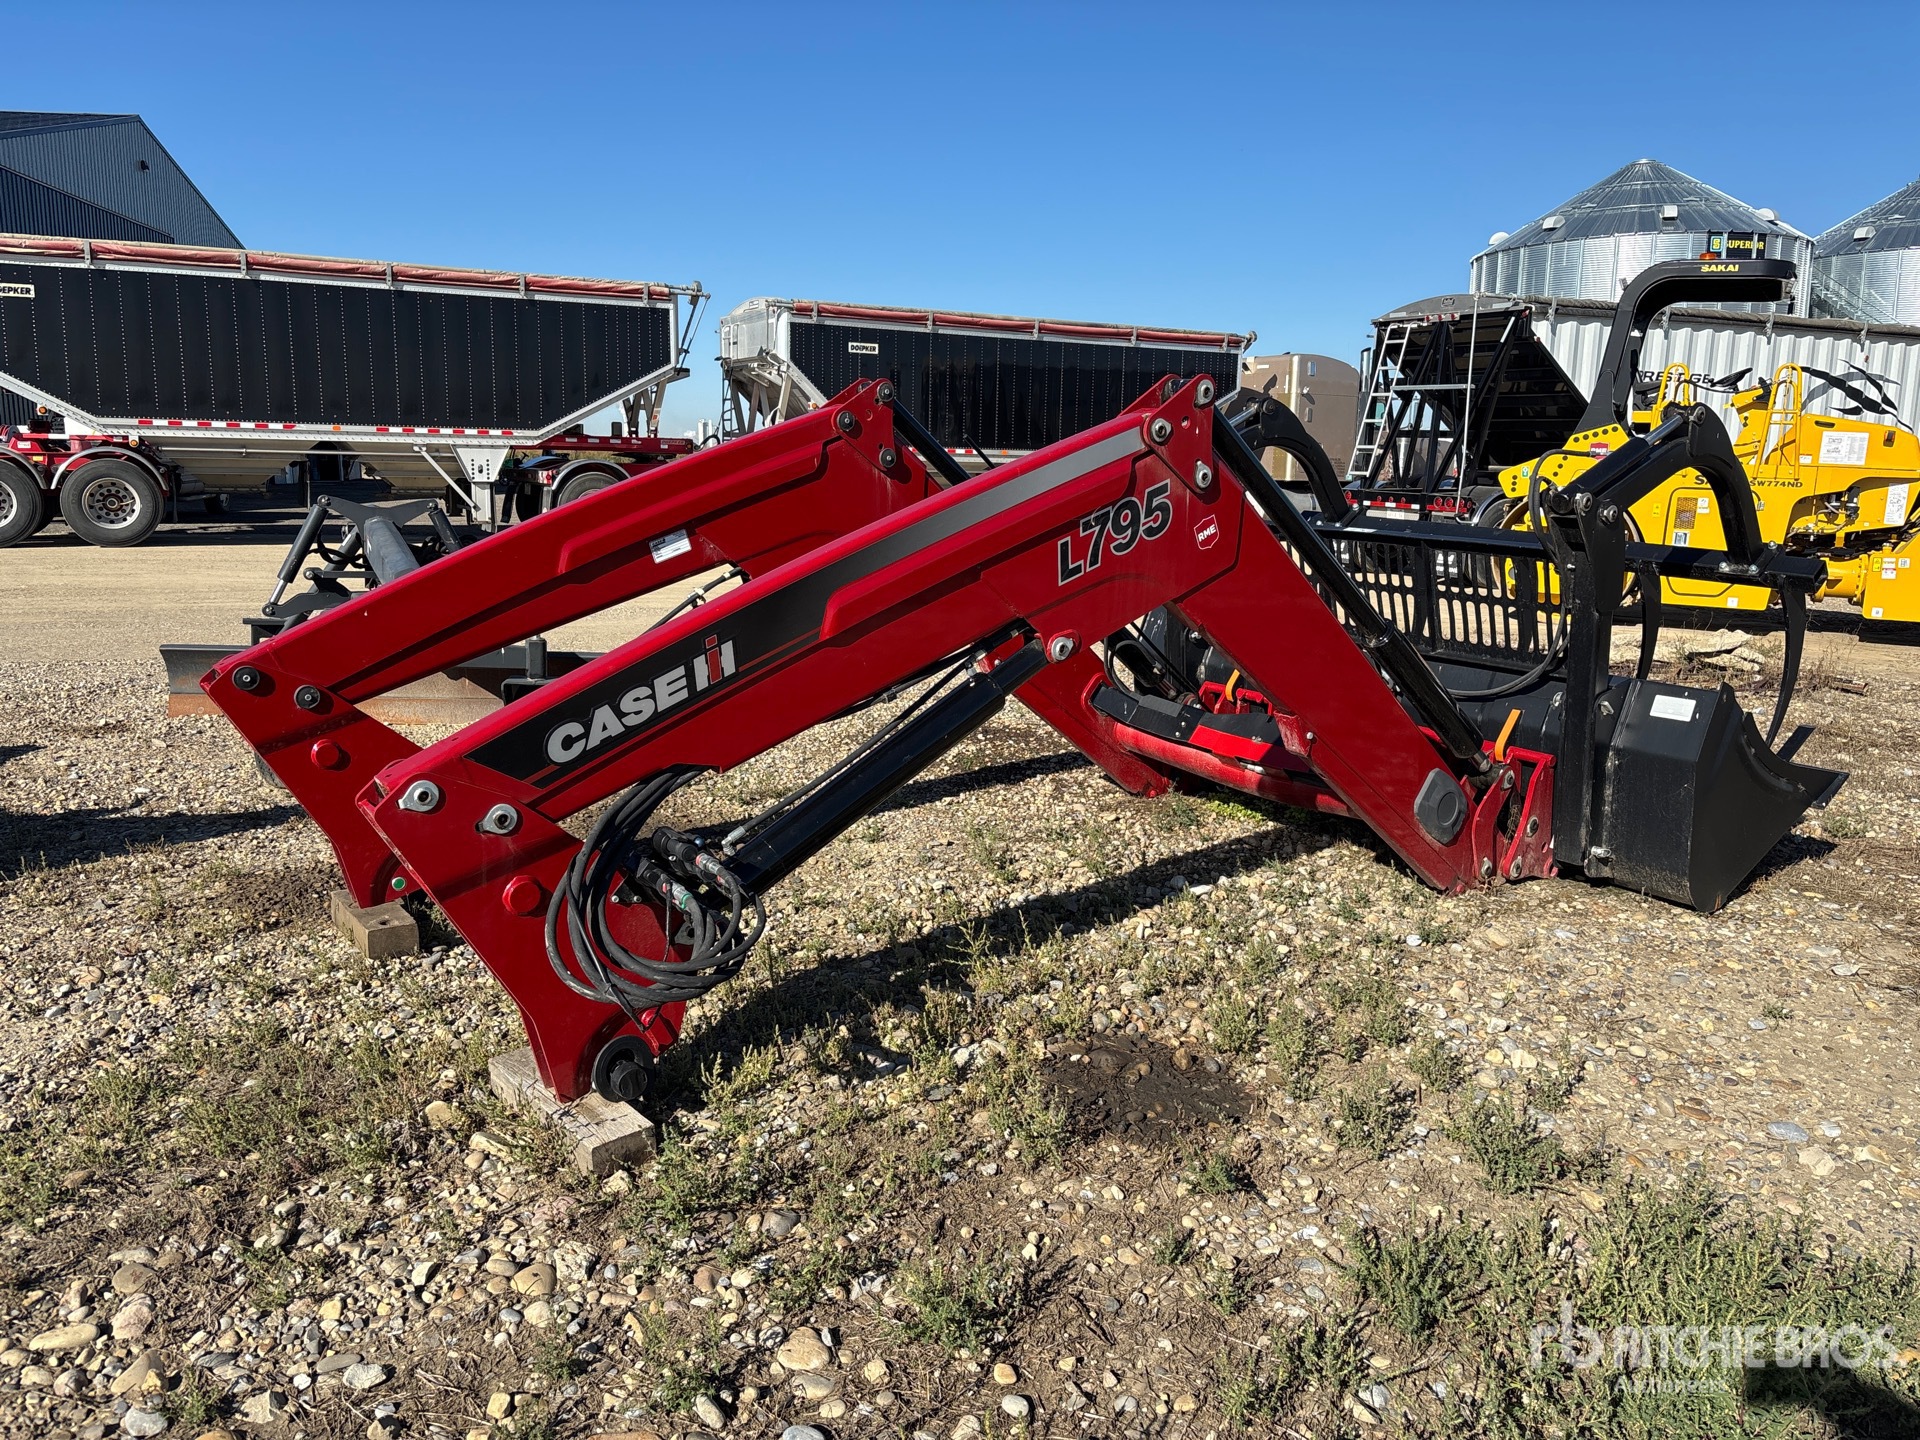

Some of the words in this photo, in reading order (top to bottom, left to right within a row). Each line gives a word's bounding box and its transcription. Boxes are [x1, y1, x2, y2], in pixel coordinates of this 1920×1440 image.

[1701, 264, 1739, 272] SAKAI
[850, 344, 877, 353] DOEPKER
[1694, 474, 1708, 485] S
[1749, 480, 1803, 488] SW774ND
[1058, 478, 1173, 587] L795
[1197, 523, 1217, 542] RME
[547, 664, 689, 763] CASE
